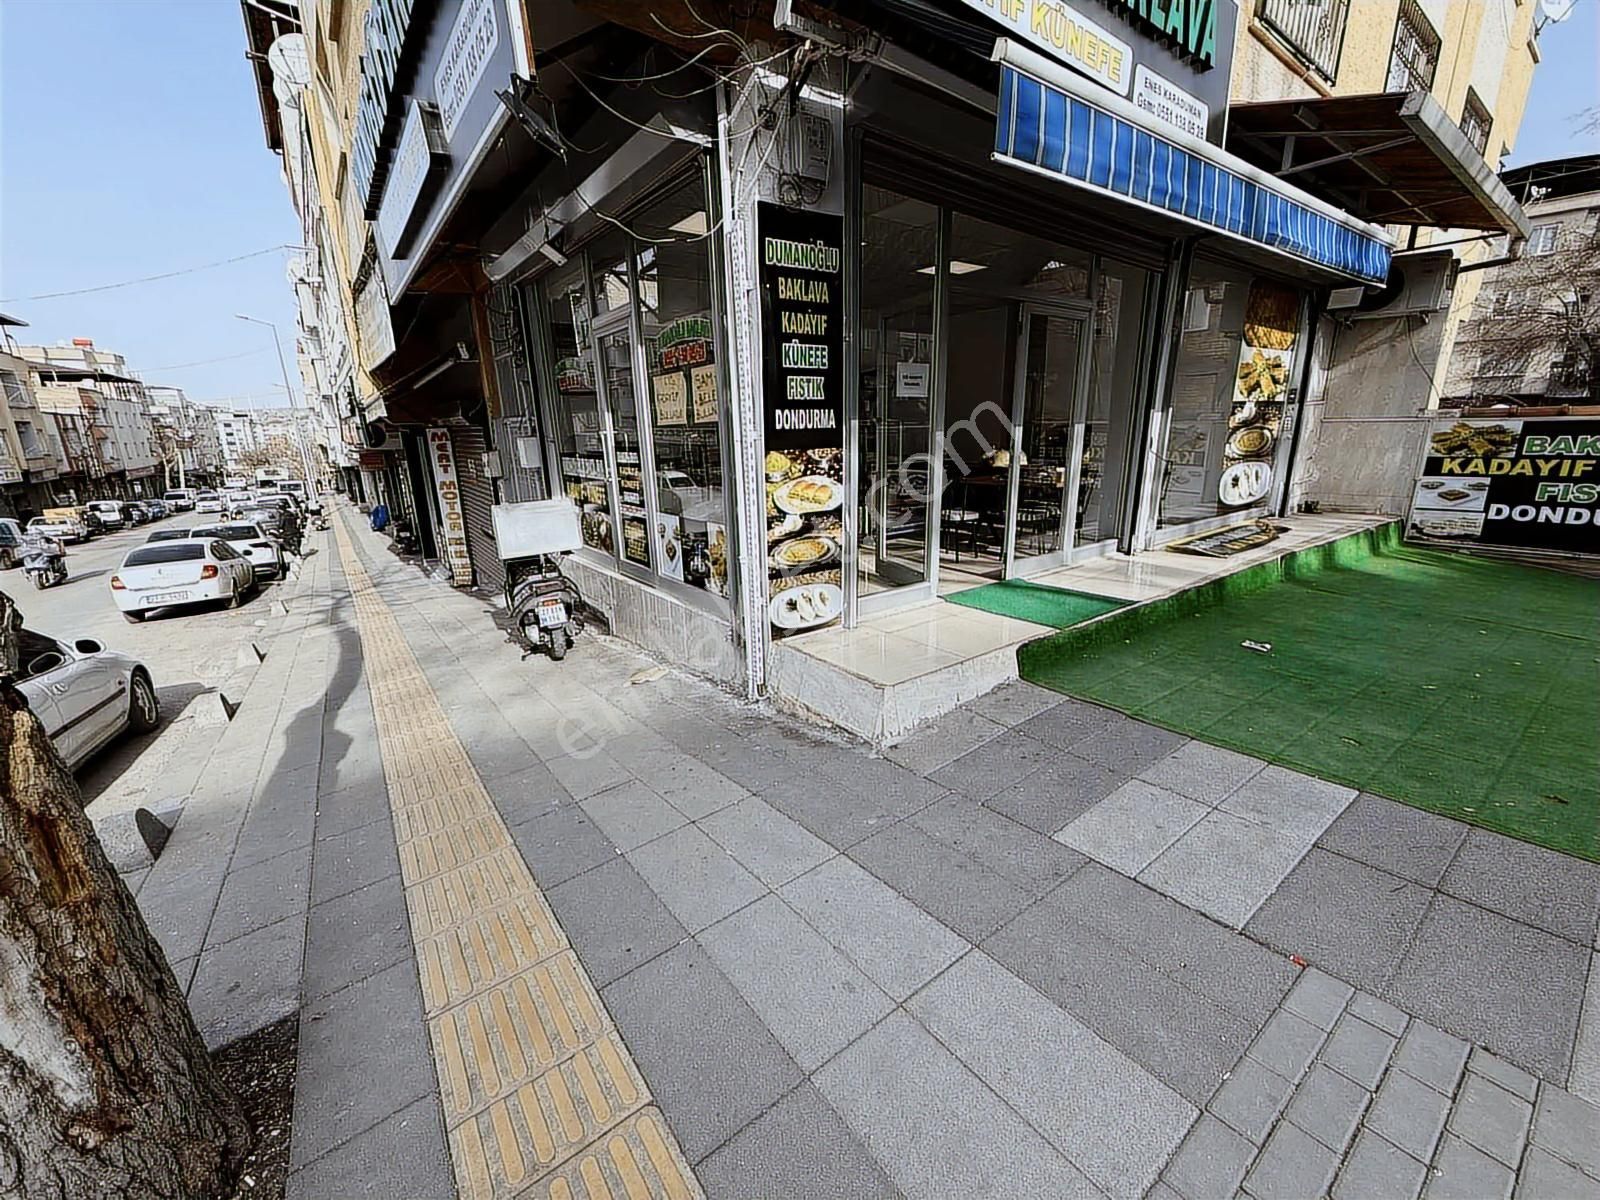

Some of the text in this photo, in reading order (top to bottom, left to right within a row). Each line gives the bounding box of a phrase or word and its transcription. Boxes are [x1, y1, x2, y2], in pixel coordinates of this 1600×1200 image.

[1030, 0, 1123, 84] KÜNEFE
[1144, 76, 1202, 120] ENES KARADUMAN
[765, 236, 839, 274] DUMANOĞLU
[778, 276, 829, 304] BAKLAVA
[781, 310, 828, 336] KADAYIF
[782, 338, 829, 369] KÜNEFE
[787, 375, 824, 400] FISTIK
[775, 408, 836, 430] DONDURMA
[1441, 458, 1597, 477] KADAYIF
[1535, 482, 1600, 503] FIS
